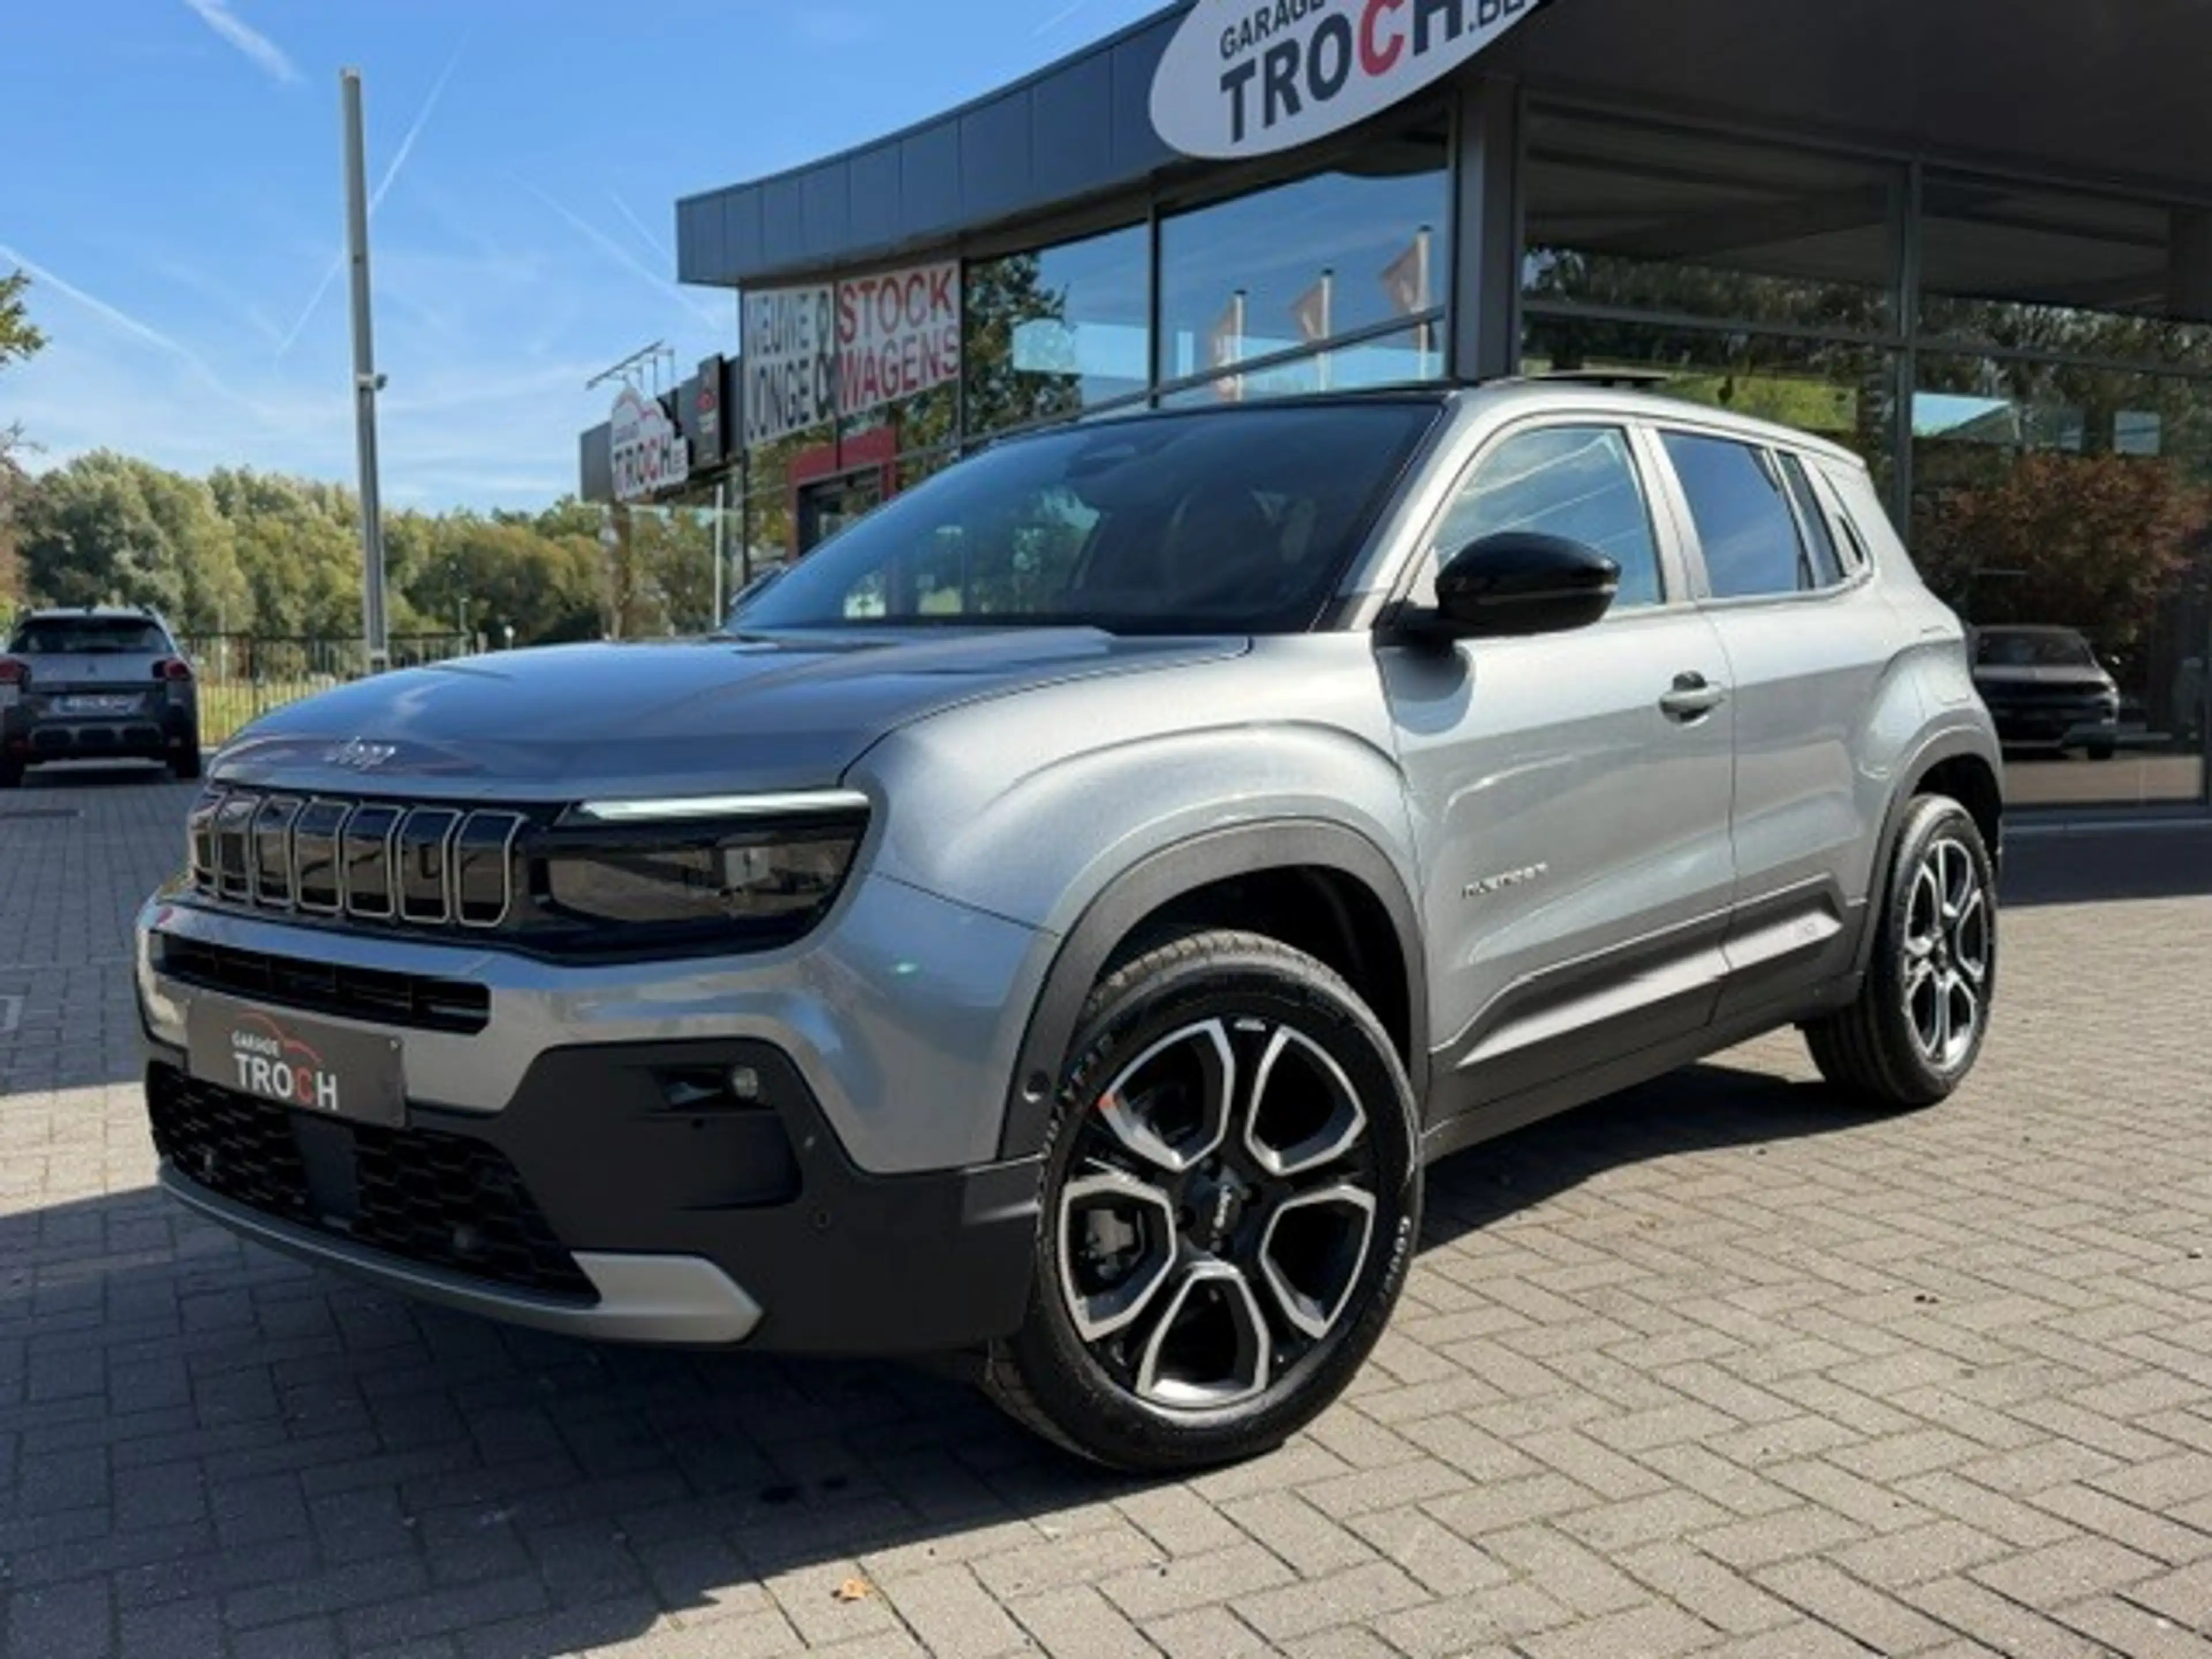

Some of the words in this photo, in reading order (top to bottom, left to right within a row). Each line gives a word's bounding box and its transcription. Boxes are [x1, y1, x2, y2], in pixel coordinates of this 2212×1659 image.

[838, 267, 957, 343] STOCK
[839, 324, 959, 412] WAGENS
[232, 1051, 339, 1111] TROCH
